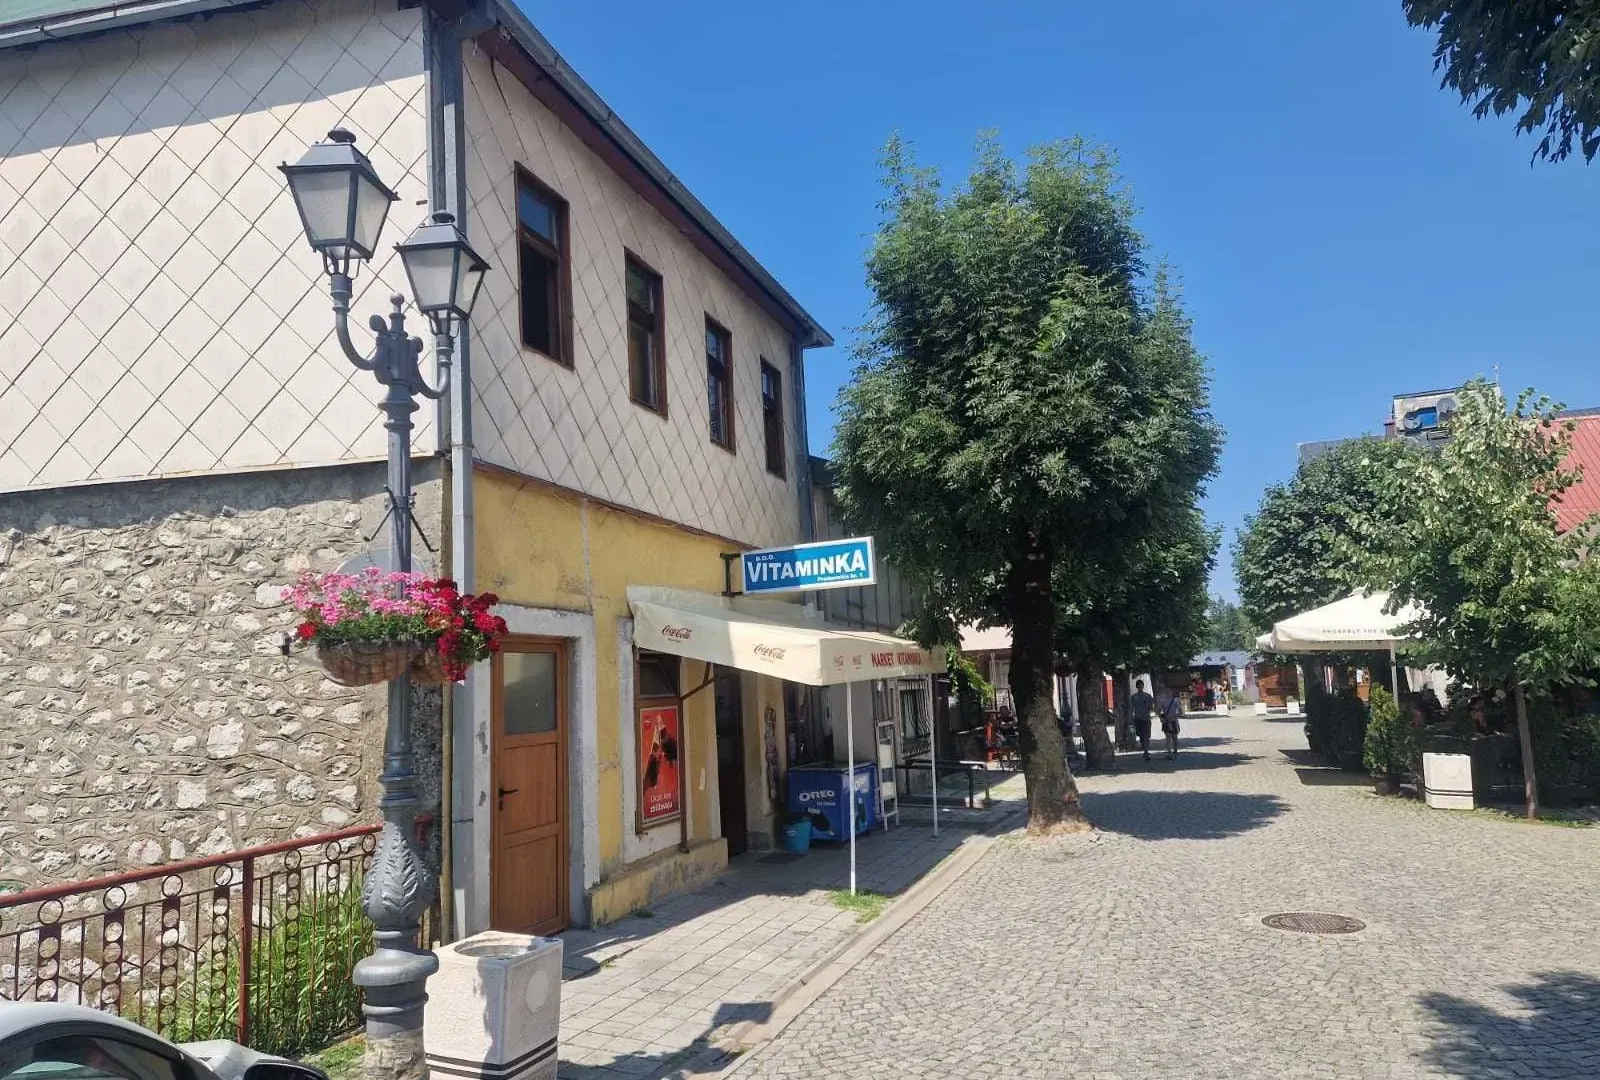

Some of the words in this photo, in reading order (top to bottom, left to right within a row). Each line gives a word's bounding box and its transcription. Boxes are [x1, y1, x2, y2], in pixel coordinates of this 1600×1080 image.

[747, 549, 866, 582] VITAMINKA
[871, 652, 895, 667] MARKET
[799, 789, 835, 802] OREO
